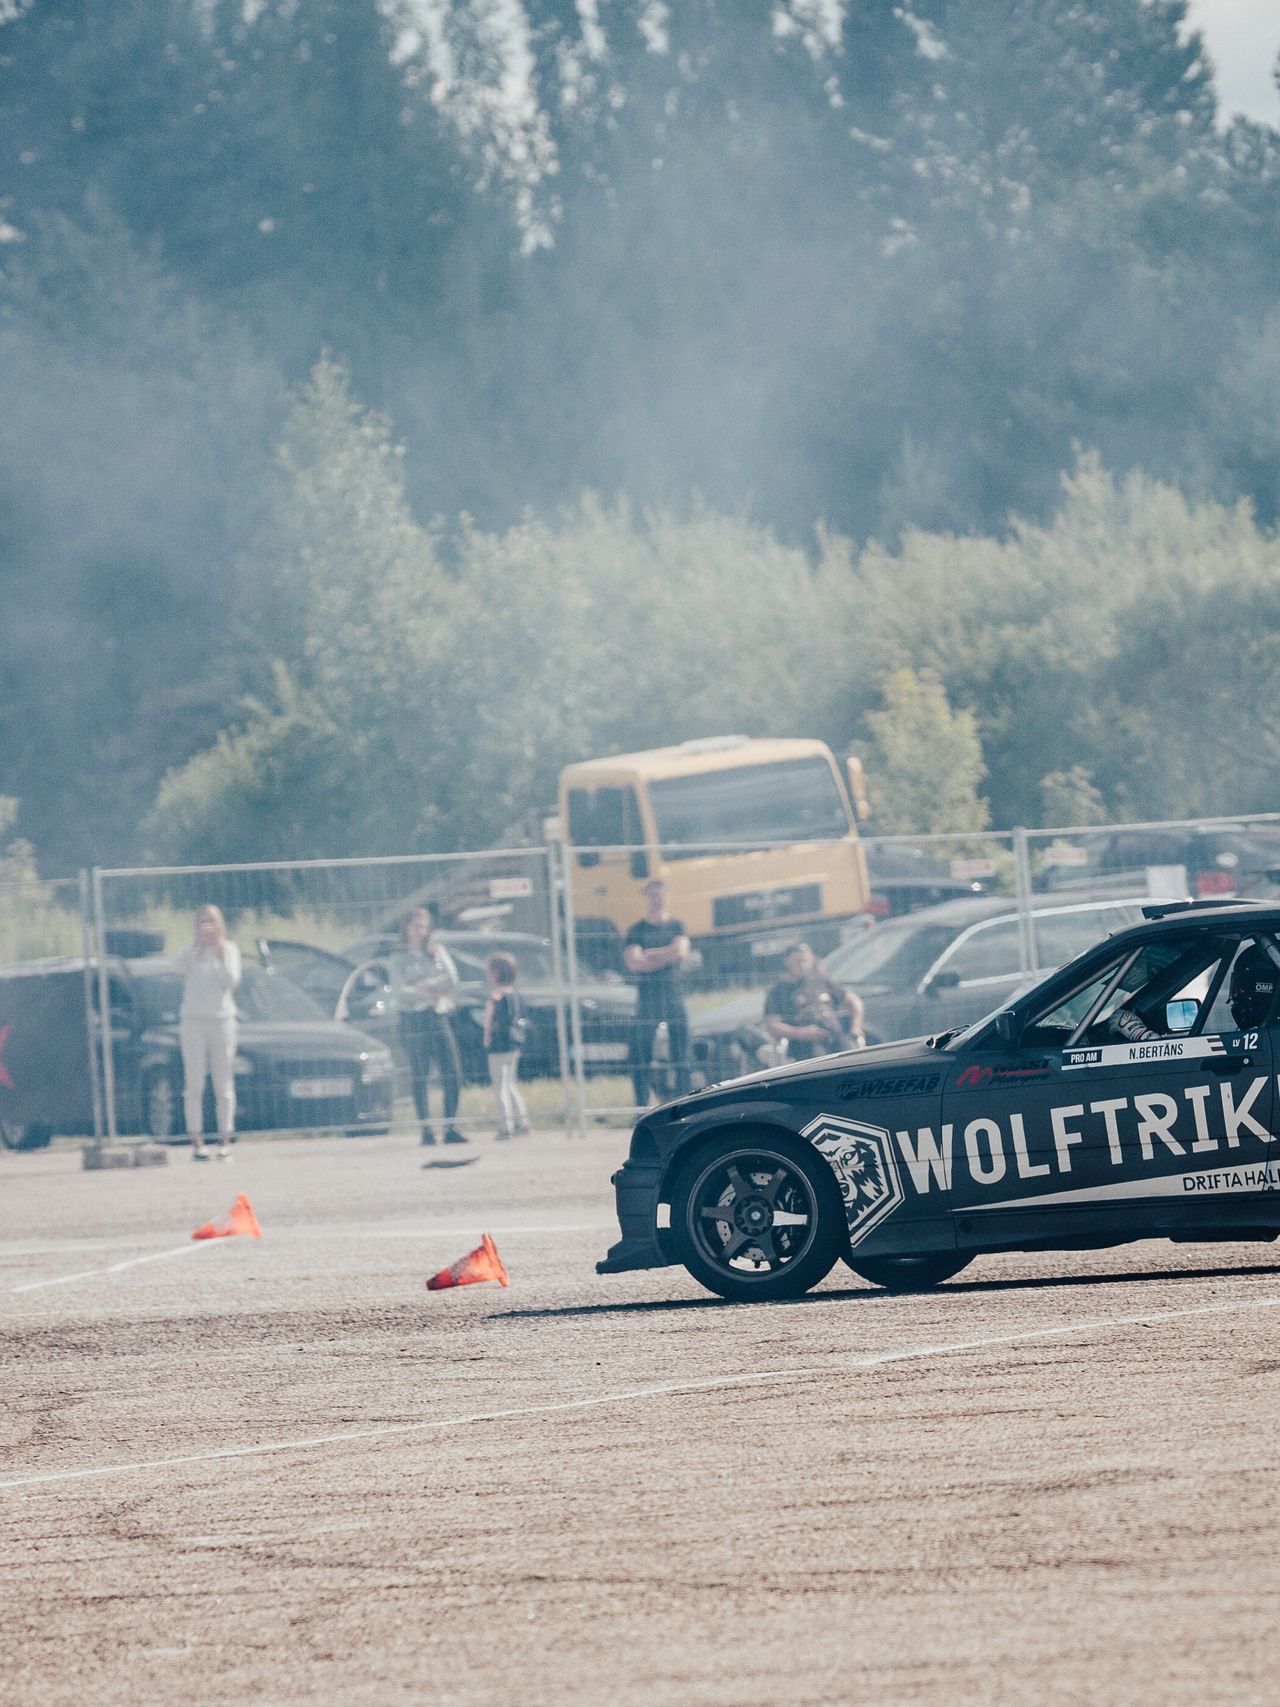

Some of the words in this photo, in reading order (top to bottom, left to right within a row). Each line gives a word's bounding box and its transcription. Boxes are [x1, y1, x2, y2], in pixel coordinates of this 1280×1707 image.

[1255, 983, 1274, 992] OMP
[1232, 1038, 1241, 1048] LV
[1243, 1032, 1259, 1050] 12
[1070, 1053, 1085, 1064] PRO
[1085, 1051, 1098, 1062] AM
[1129, 1043, 1184, 1060] N.BERTĀNS
[860, 1076, 941, 1096] WISEFAB
